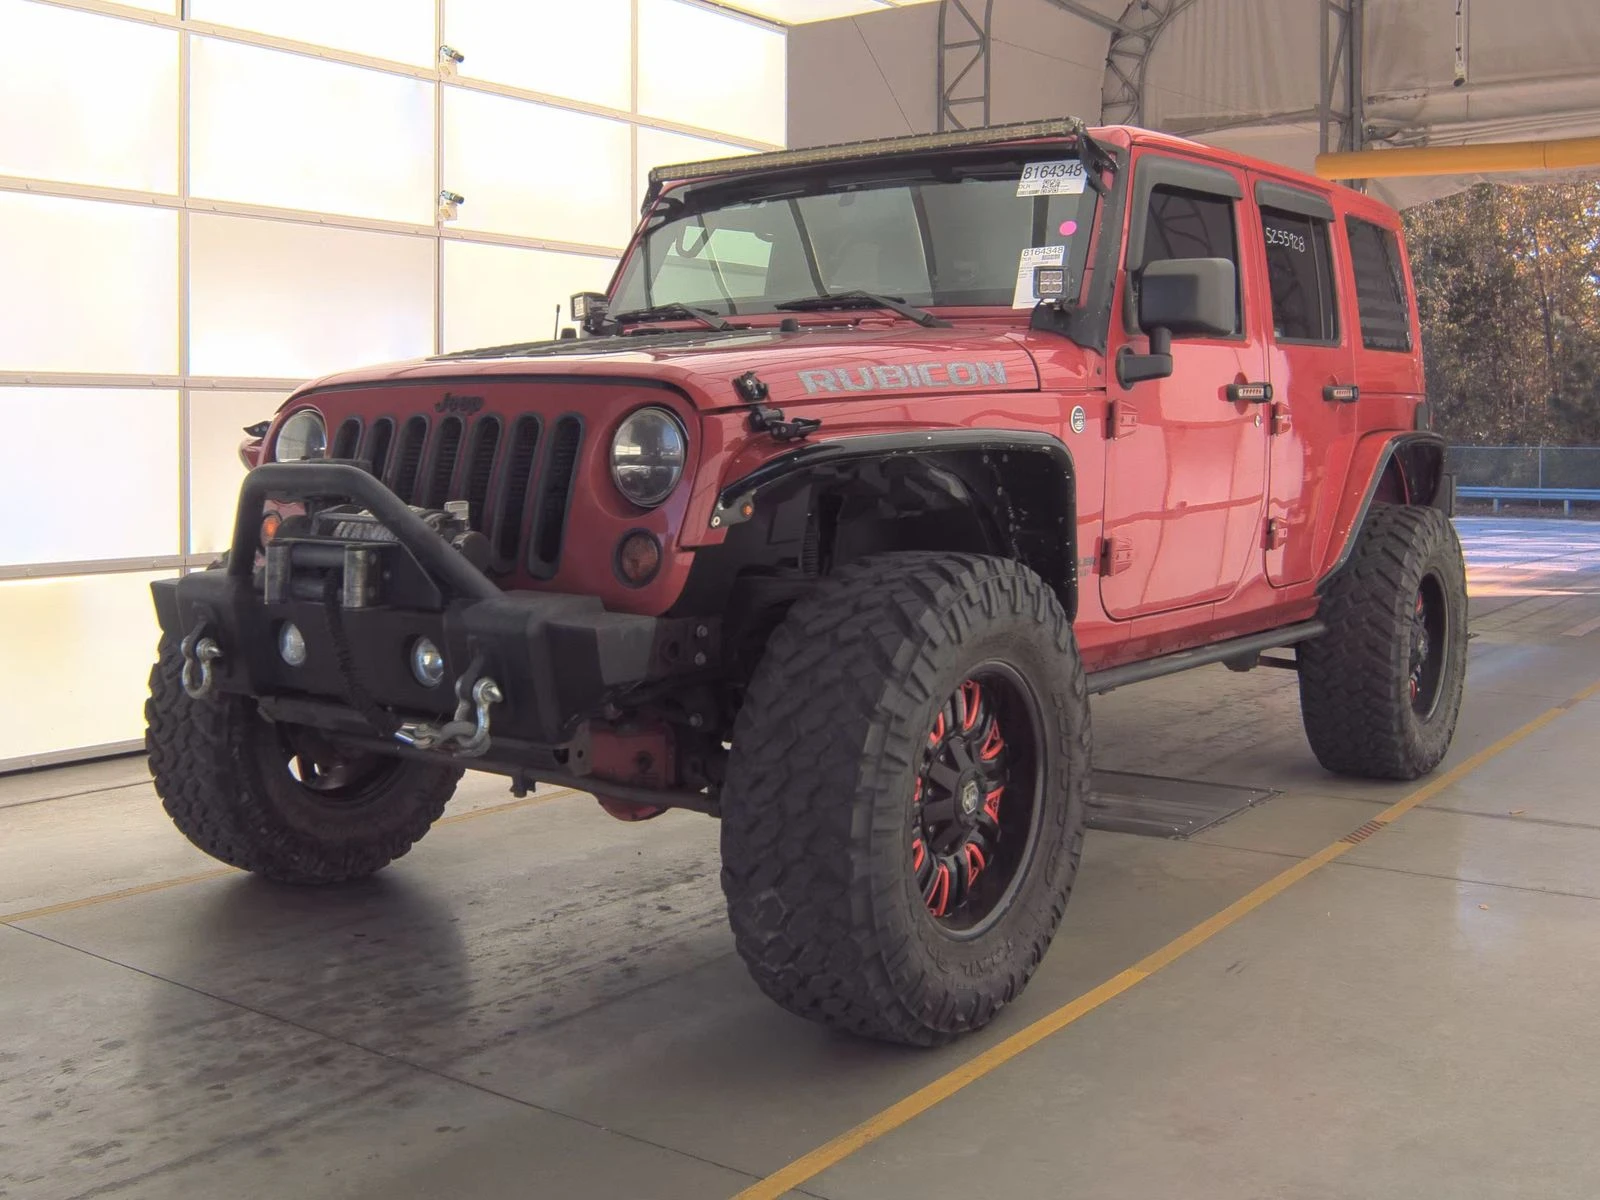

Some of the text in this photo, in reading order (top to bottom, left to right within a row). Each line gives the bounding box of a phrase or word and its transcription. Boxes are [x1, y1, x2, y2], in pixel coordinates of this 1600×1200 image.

[1023, 164, 1083, 180] 8164348
[1023, 246, 1064, 257] 8164348
[797, 360, 1008, 396] RUBICON
[434, 391, 485, 416] Jeep
